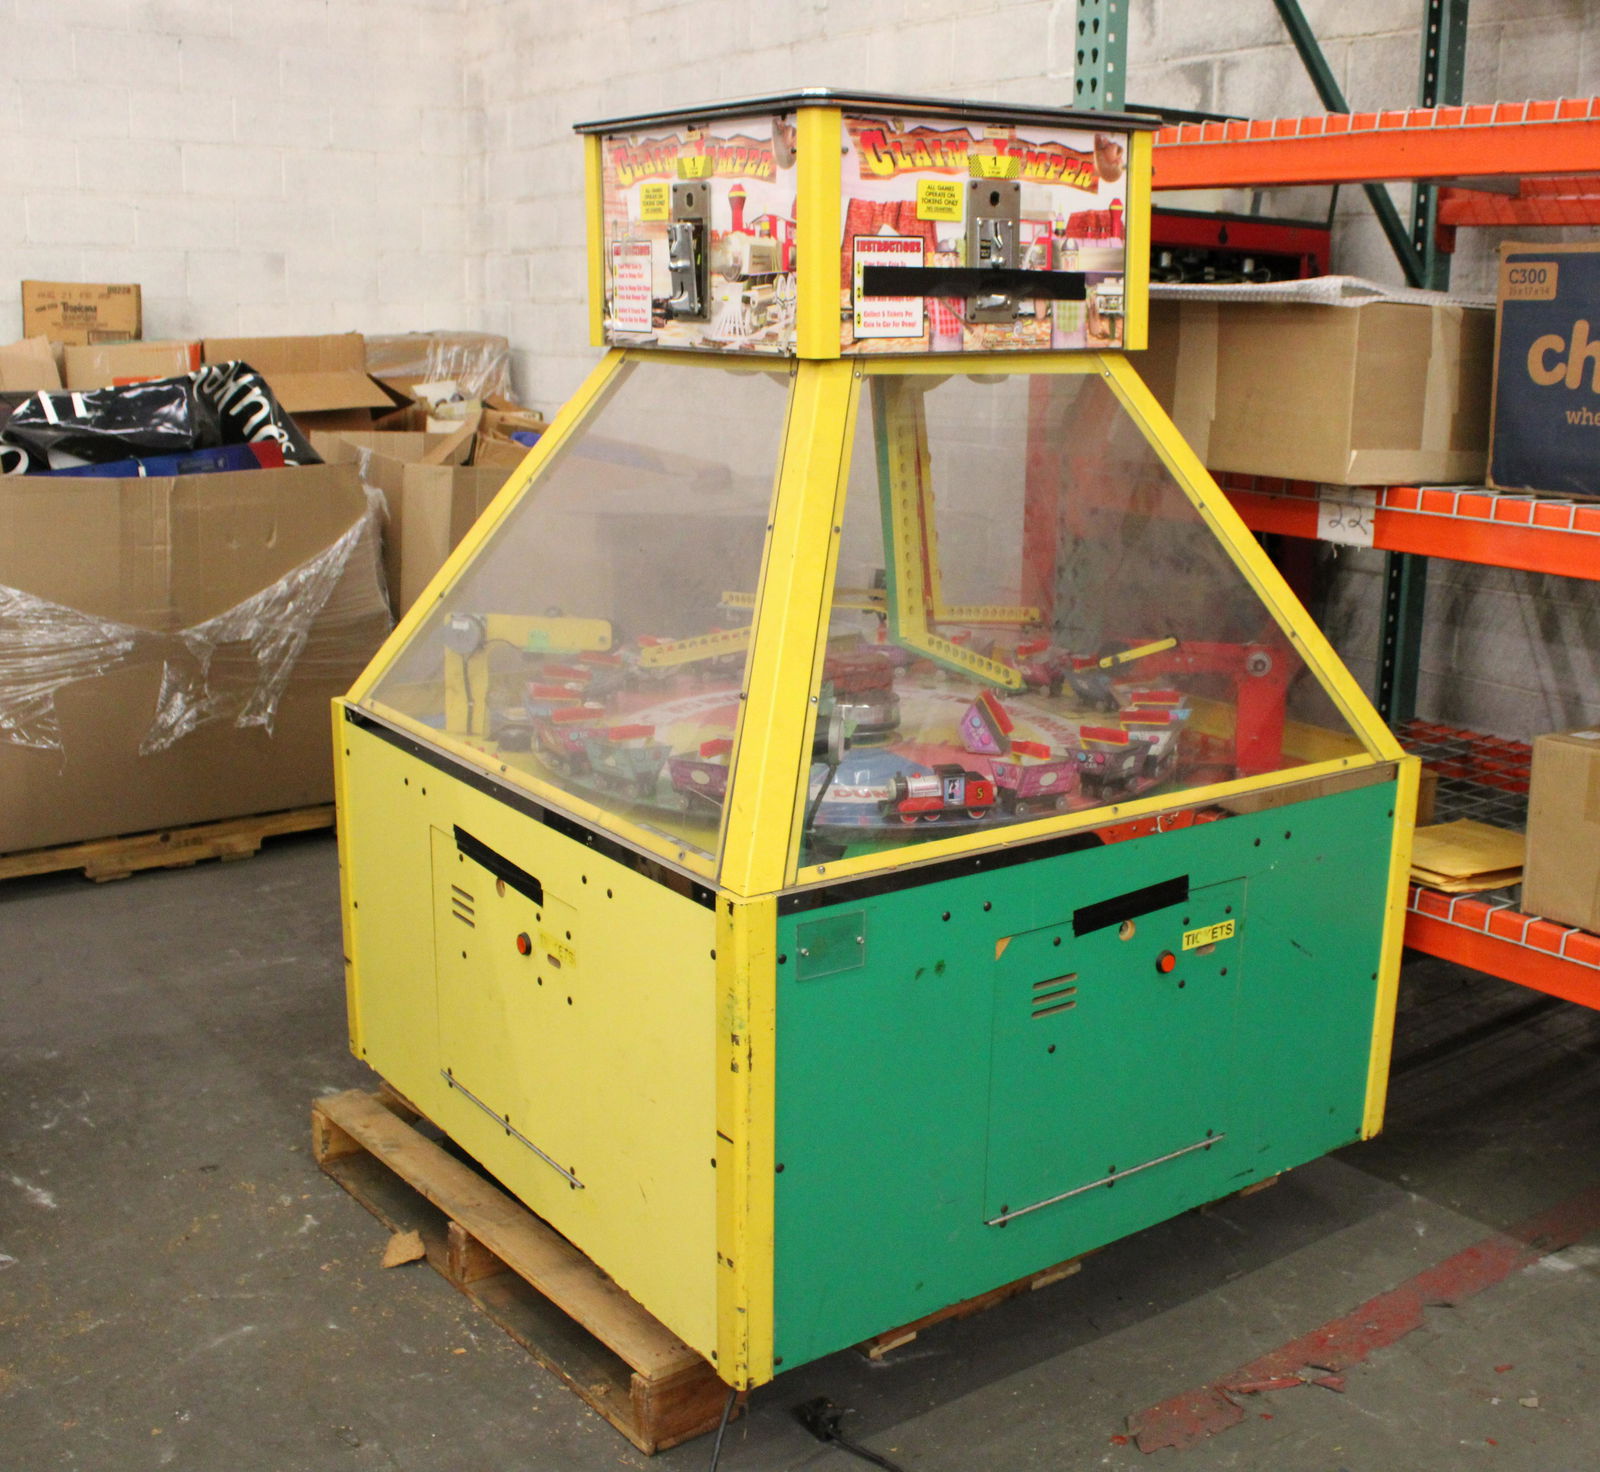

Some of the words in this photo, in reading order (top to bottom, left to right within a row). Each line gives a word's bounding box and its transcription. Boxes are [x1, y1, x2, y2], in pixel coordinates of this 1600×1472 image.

[856, 240, 922, 253] INSTRUCTIONS
[1509, 268, 1547, 284] C300
[61, 301, 97, 314] Tropicana
